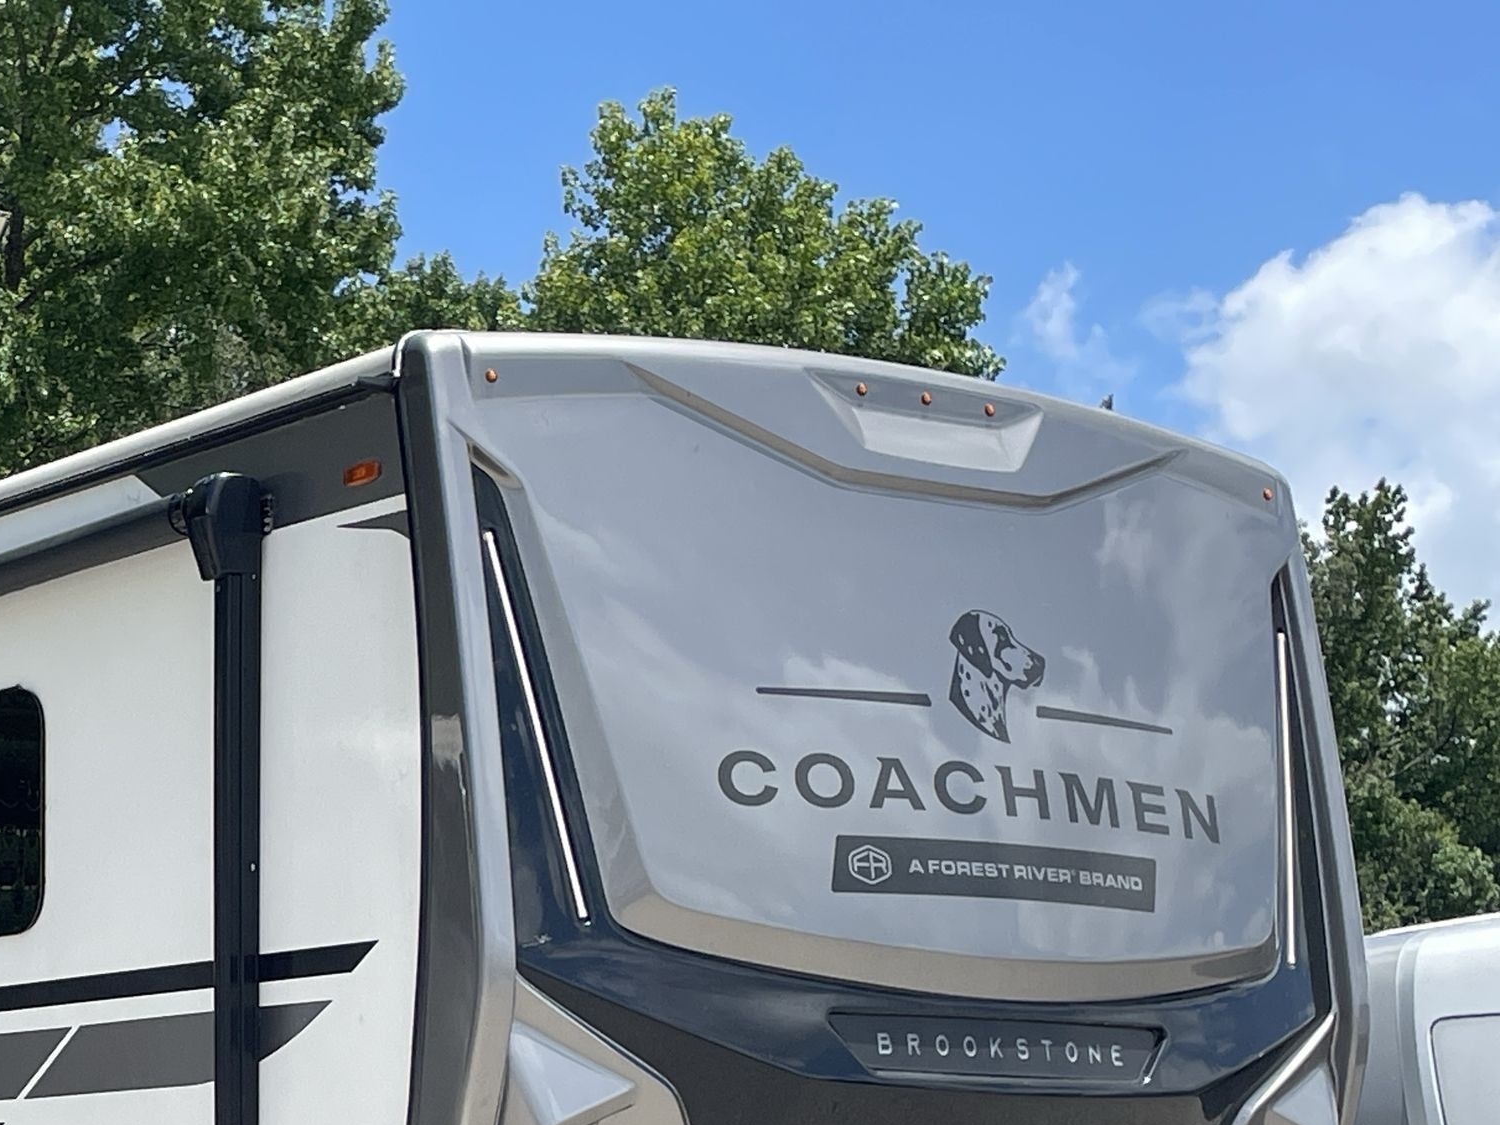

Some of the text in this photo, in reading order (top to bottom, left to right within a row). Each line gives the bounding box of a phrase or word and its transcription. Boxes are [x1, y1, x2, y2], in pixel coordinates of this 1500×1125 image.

[717, 749, 1221, 845] COACHMEN
[908, 859, 925, 874] A
[927, 859, 1010, 879] FOREST
[1078, 871, 1143, 892] BRAND
[876, 1032, 1125, 1067] BROOKSTONE
